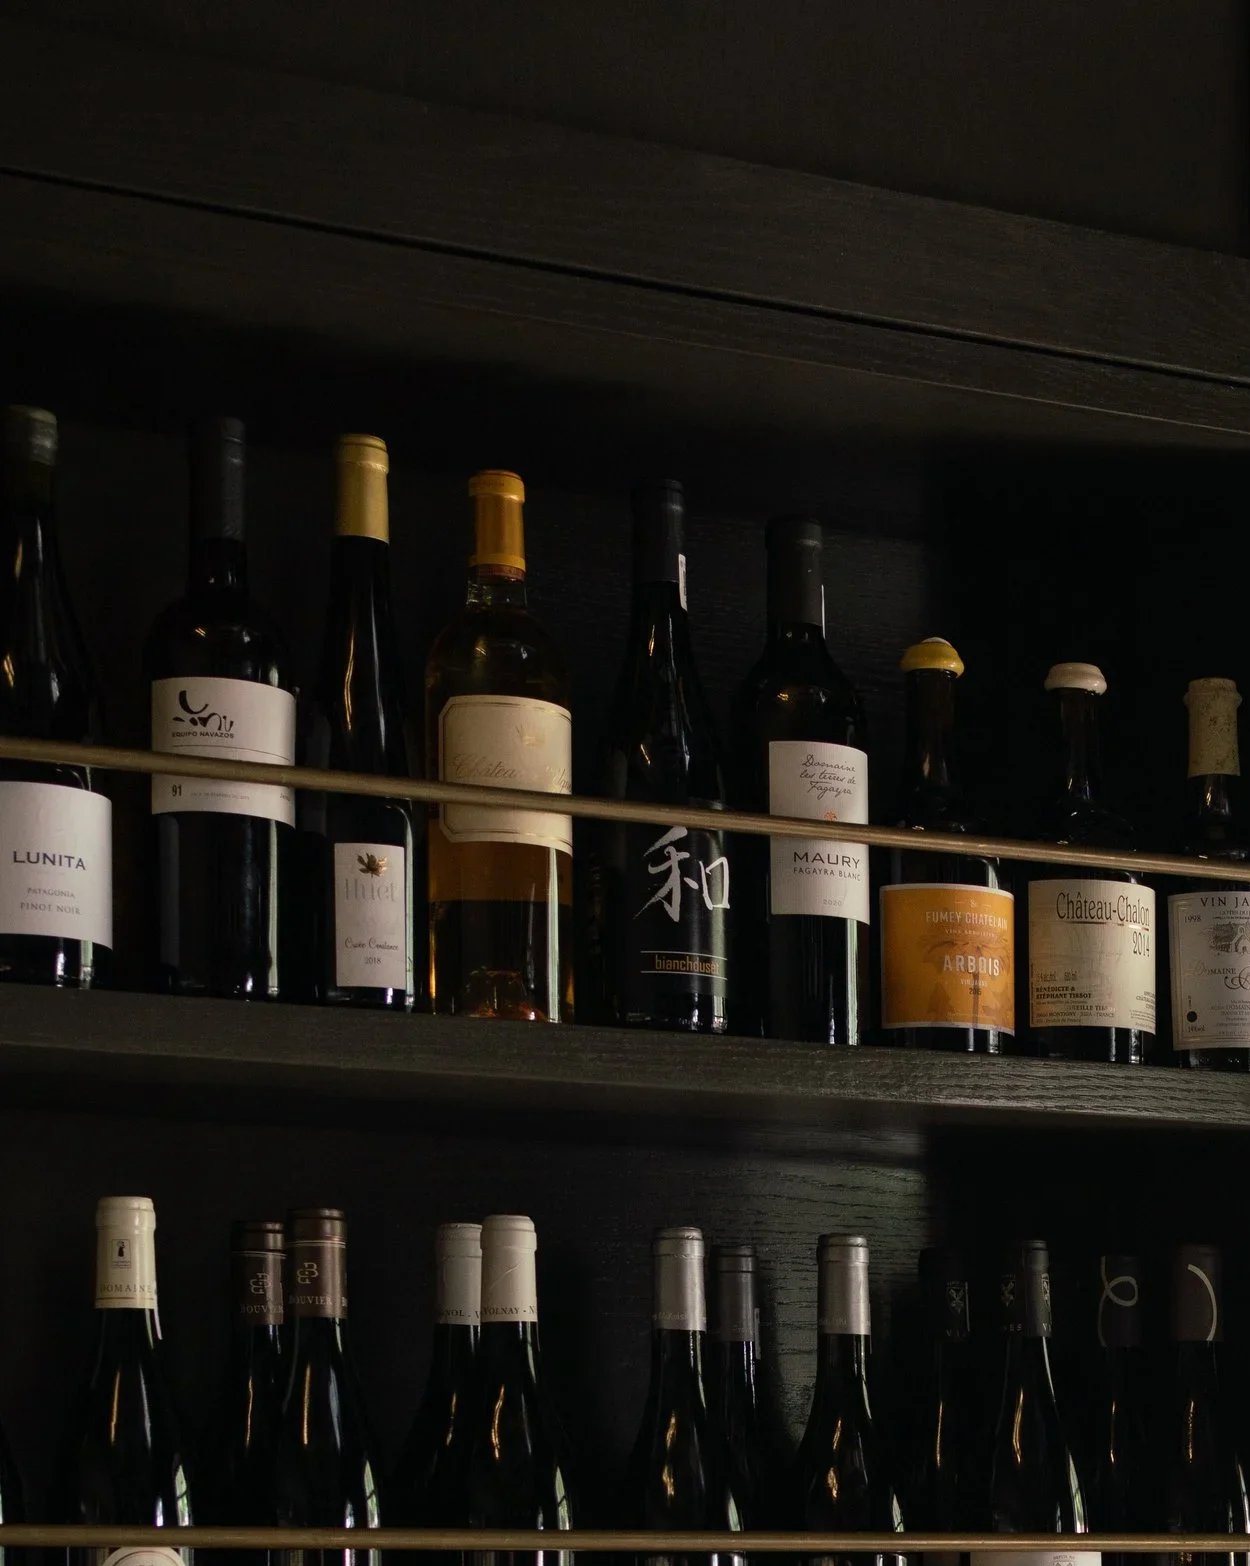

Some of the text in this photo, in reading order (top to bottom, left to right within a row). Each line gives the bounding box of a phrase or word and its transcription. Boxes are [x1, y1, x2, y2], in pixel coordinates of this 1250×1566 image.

[802, 754, 856, 773] Domaine
[818, 770, 845, 782] terres
[847, 776, 856, 785] de
[171, 784, 182, 796] 91
[807, 781, 852, 800] Fagayra
[13, 851, 86, 870] LUNITA
[793, 851, 860, 869] MAURY
[633, 826, 730, 923] 和
[793, 867, 861, 881] FAGAYRA BLANC
[27, 887, 75, 899] PATAGONIA
[20, 902, 81, 915] PINOT NOIR
[1056, 892, 1150, 926] Château-Chalon
[1200, 896, 1227, 907] VIN
[925, 911, 1008, 930] FUMEY CHATELAIN
[1132, 931, 1150, 957] 2014
[365, 957, 382, 965] 2018
[943, 954, 1000, 976] ARBOIS
[100, 1284, 152, 1293] DOMAINE
[289, 1295, 333, 1305] BOUVIER
[483, 1307, 519, 1315] VOLNAY
